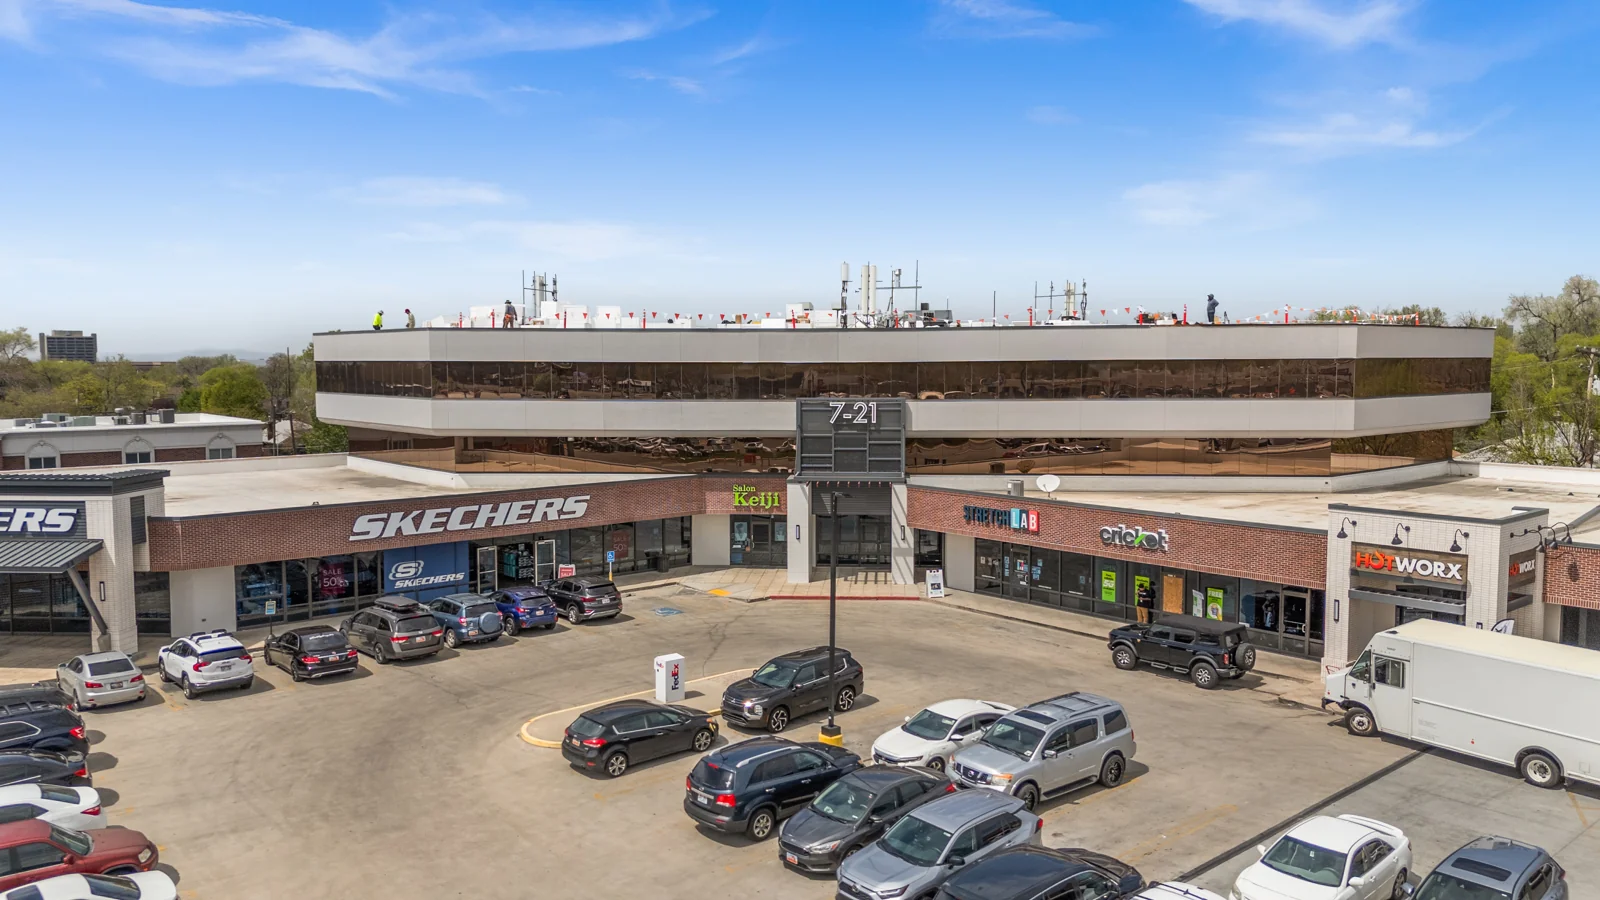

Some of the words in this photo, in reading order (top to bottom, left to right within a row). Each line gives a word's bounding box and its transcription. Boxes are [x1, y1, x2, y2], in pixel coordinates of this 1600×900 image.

[829, 401, 877, 424] 7-21
[732, 484, 756, 492] Salon
[733, 492, 780, 509] Keiji
[348, 495, 591, 541] SKECHERS
[1099, 524, 1169, 551] cricket
[1355, 550, 1463, 580] HOTWORX
[394, 572, 466, 589] SKECHERS
[671, 663, 680, 691] FedEx
